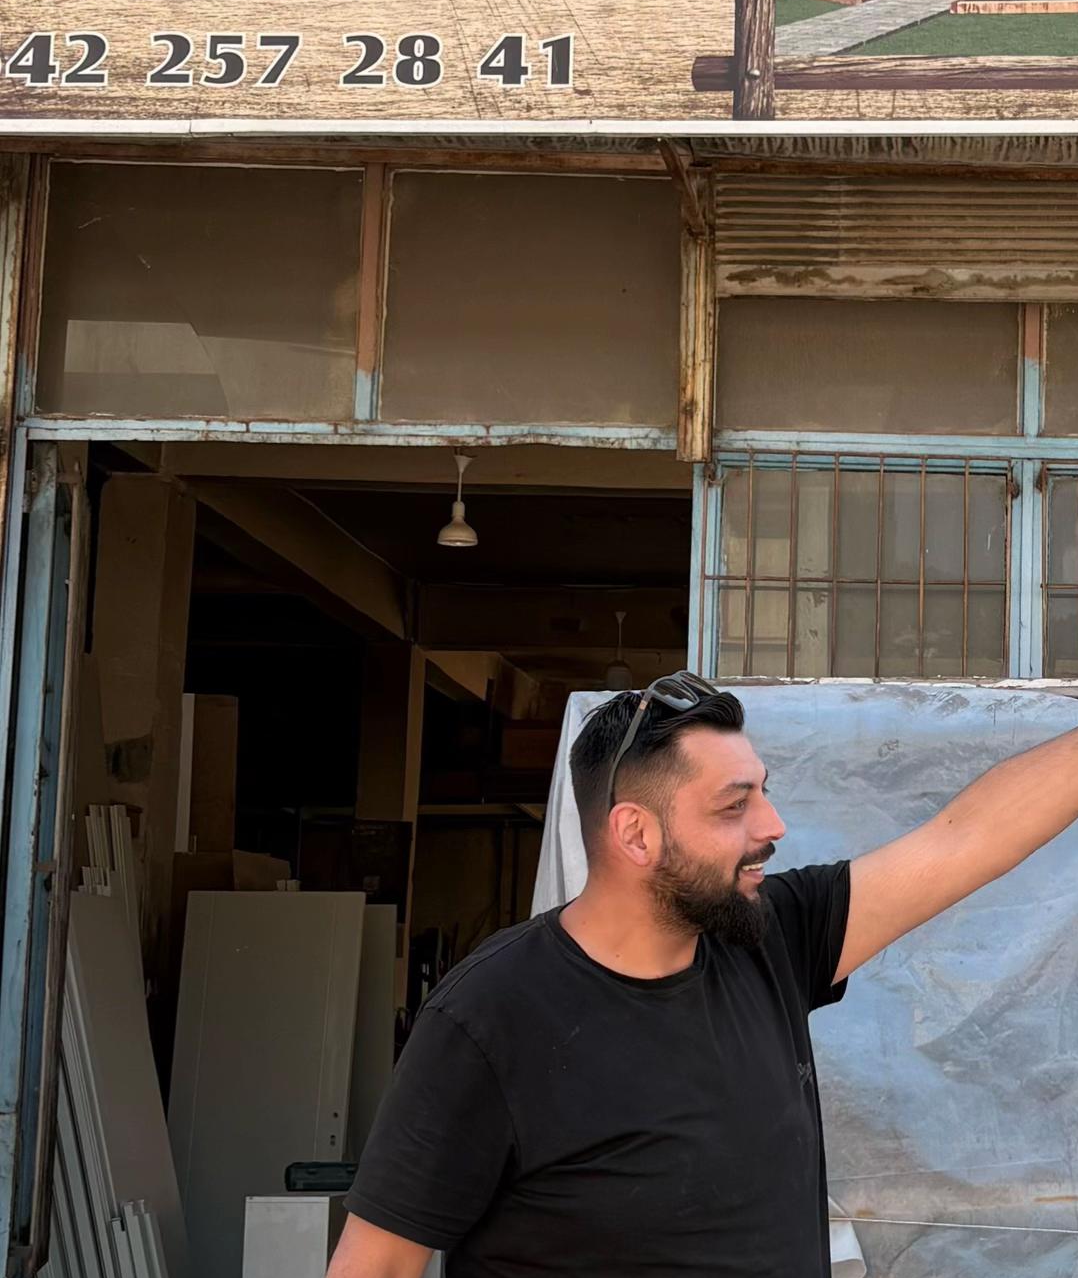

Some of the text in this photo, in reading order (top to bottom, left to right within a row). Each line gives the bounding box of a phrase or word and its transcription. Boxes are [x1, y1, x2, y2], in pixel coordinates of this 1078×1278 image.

[147, 32, 302, 88] 257
[339, 33, 443, 89] 28
[477, 32, 576, 89] 41
